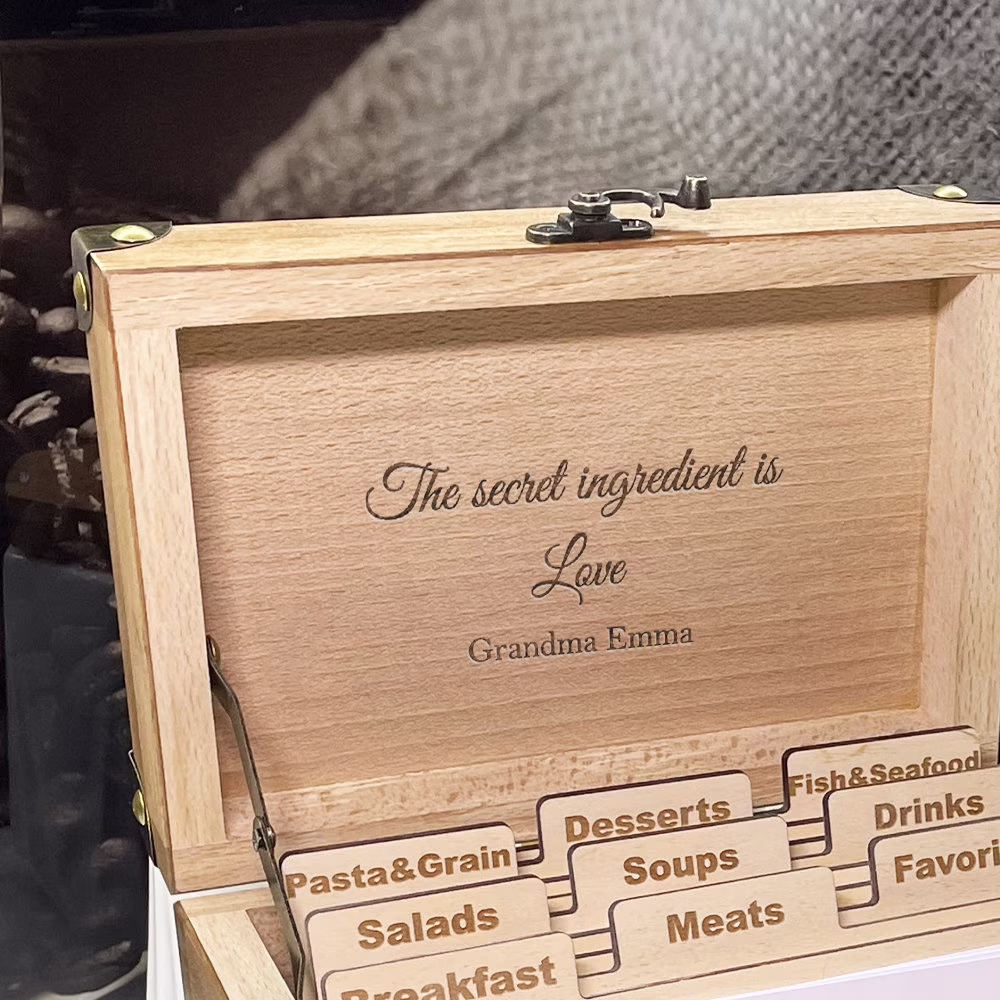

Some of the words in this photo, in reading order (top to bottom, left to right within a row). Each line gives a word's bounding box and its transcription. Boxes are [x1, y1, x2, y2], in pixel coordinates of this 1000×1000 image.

[366, 461, 460, 520] The
[472, 459, 568, 508] secret
[577, 445, 747, 517] ingredient
[754, 453, 784, 486] is
[531, 532, 627, 606] Love
[468, 631, 597, 663] Grandma
[607, 625, 694, 650] Emma
[788, 751, 979, 796] Fish&Seafood
[565, 798, 731, 842] Desserts
[874, 793, 985, 830] Drinks
[285, 846, 511, 898] Pasta&Grain
[623, 849, 739, 885] Soups
[357, 904, 500, 950] Salads
[666, 900, 785, 944] Meats
